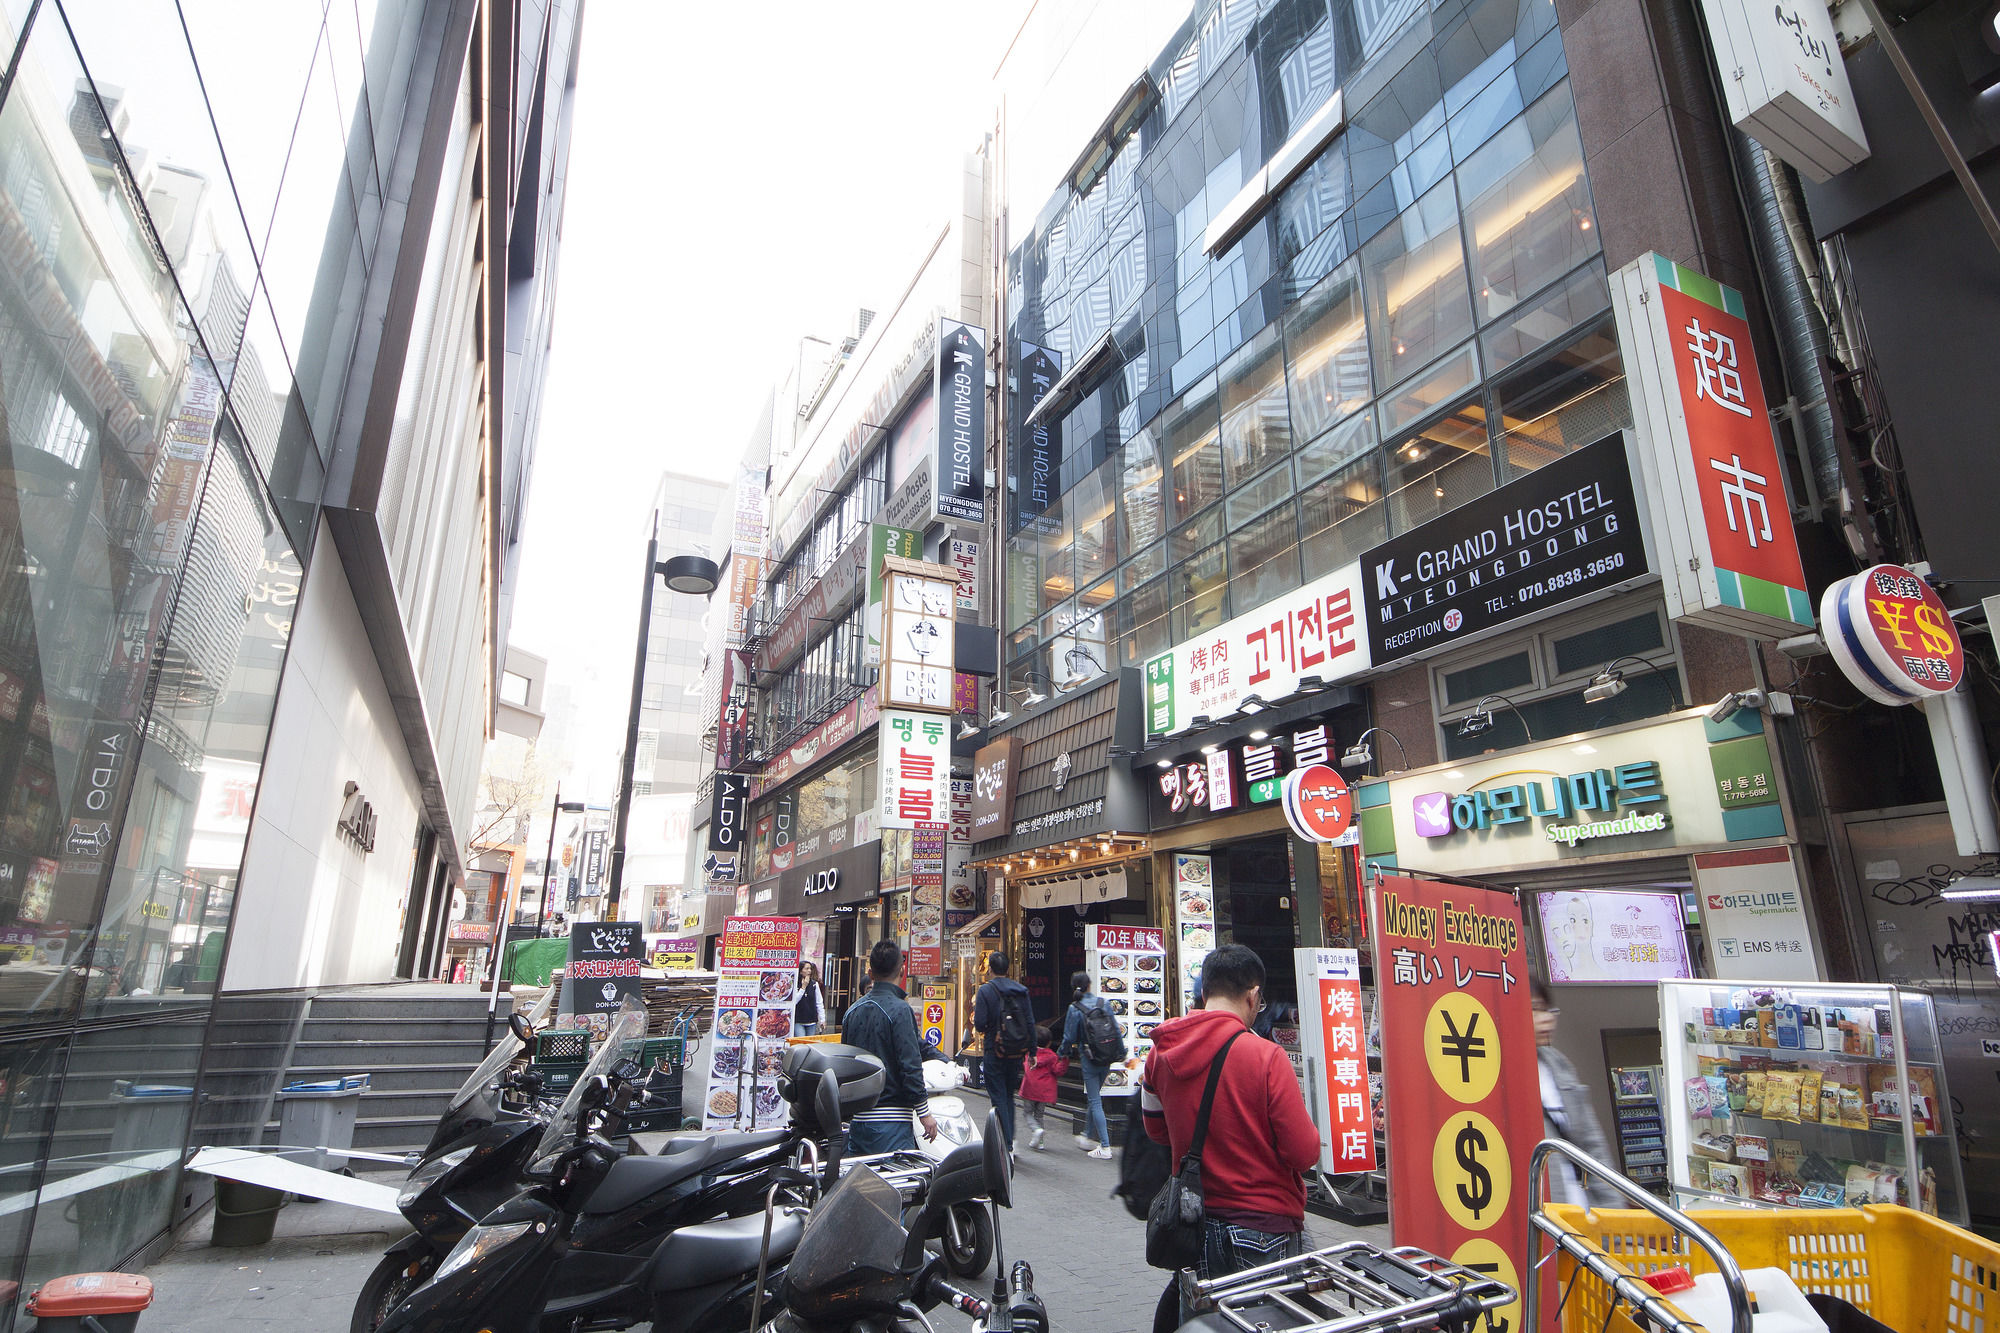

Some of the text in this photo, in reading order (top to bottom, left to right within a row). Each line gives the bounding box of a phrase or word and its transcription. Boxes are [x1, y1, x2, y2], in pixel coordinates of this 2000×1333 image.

[1794, 63, 1841, 108] Take out
[953, 350, 973, 490] K-GRAND HOSTEL
[1686, 317, 1774, 548] 超市
[886, 472, 928, 525] Pizza.Pasta
[940, 495, 983, 510] MYEONGDONG
[1503, 482, 1613, 546] HOSTEL
[887, 529, 900, 556] Par
[952, 541, 977, 555] 삼원
[1518, 552, 1625, 602] 070.8838.3650
[768, 626, 795, 663] Parking
[1246, 588, 1356, 686] 고기전문
[1385, 611, 1462, 650] RECEPTION 3F
[1149, 657, 1171, 680] 명동
[1190, 638, 1229, 675] 烤肉
[892, 718, 944, 745] 명동
[898, 747, 935, 820] 늘봄
[950, 781, 973, 792] 삼원
[1160, 762, 1207, 813] 명동
[1301, 786, 1347, 802] ハーモニー
[1452, 760, 1668, 831] 하모니마트
[1720, 773, 1767, 792] 명동점
[1722, 787, 1769, 801] T.776-5696
[718, 781, 735, 845] ALDO
[975, 812, 1000, 827] DON-DON
[1314, 806, 1341, 823] マート
[1546, 811, 1668, 847] Supermarket
[588, 832, 602, 882] CULTURE STAR
[803, 867, 839, 897] ALDO
[1723, 891, 1797, 909] 하모니마트
[1384, 891, 1518, 959] Money Exchange
[1749, 905, 1798, 917] Supermarket
[726, 947, 755, 957] 批发价
[1743, 940, 1802, 953] EMS 特送
[574, 957, 640, 979] 欢迎光临
[1392, 948, 1517, 994] 高い レート
[928, 1028, 939, 1045] $
[1441, 1010, 1486, 1083] ¥
[1455, 1120, 1493, 1220] $
